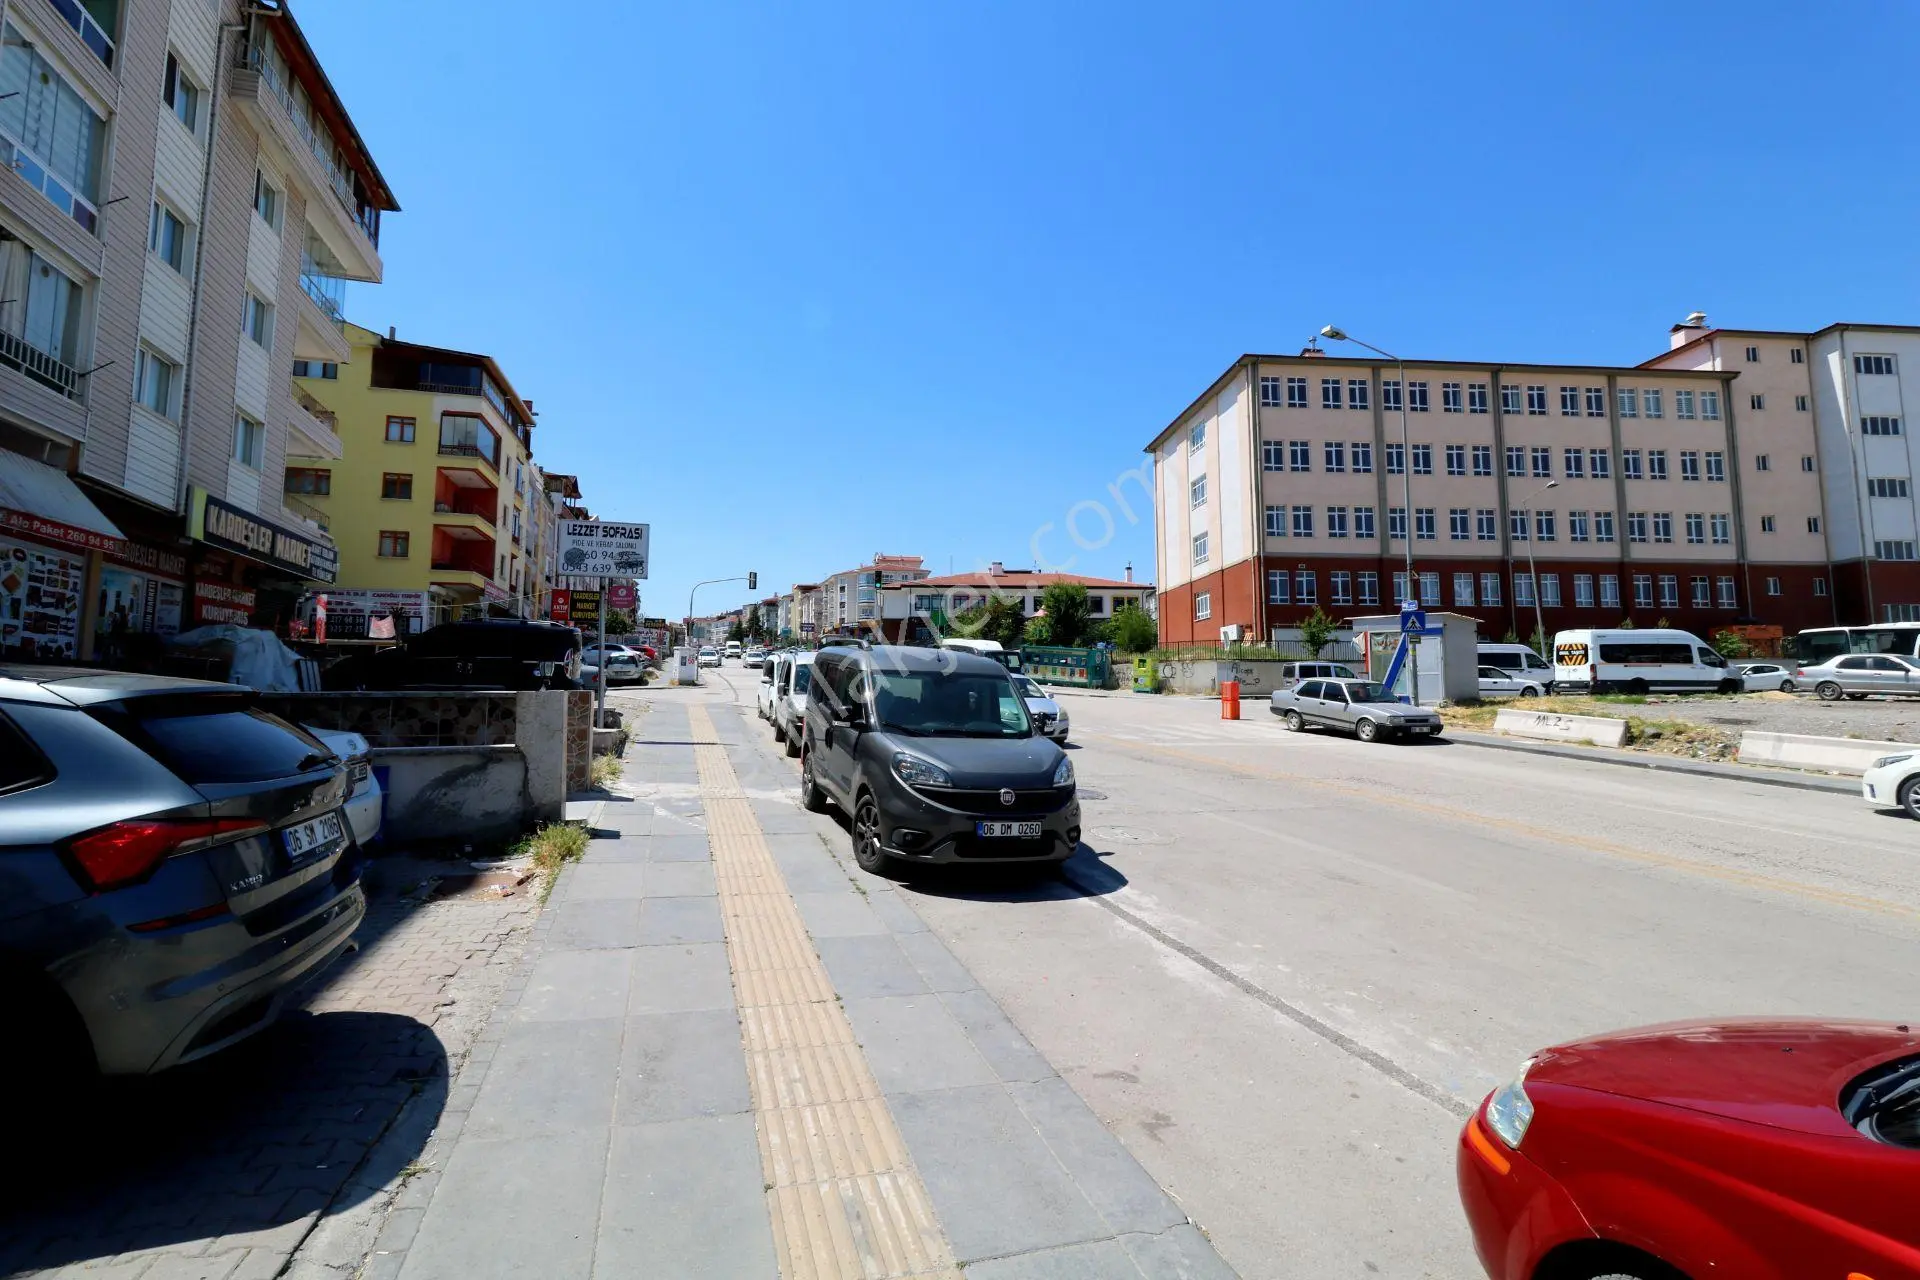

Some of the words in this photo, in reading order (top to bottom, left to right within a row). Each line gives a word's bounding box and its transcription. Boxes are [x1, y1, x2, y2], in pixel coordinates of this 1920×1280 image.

[10, 515, 29, 529] Alo
[32, 520, 65, 538] Paket
[67, 530, 86, 543] 260
[88, 536, 100, 547] 94
[103, 539, 115, 551] 95
[567, 524, 600, 538] LEZZET
[602, 526, 642, 540] SOFRASI
[276, 533, 312, 569] MARKET
[601, 550, 614, 560] 94
[592, 564, 612, 573] 639
[983, 823, 995, 835] 06
[1001, 823, 1013, 835] DM
[1018, 823, 1040, 835] 0260
[288, 829, 303, 853] 06
